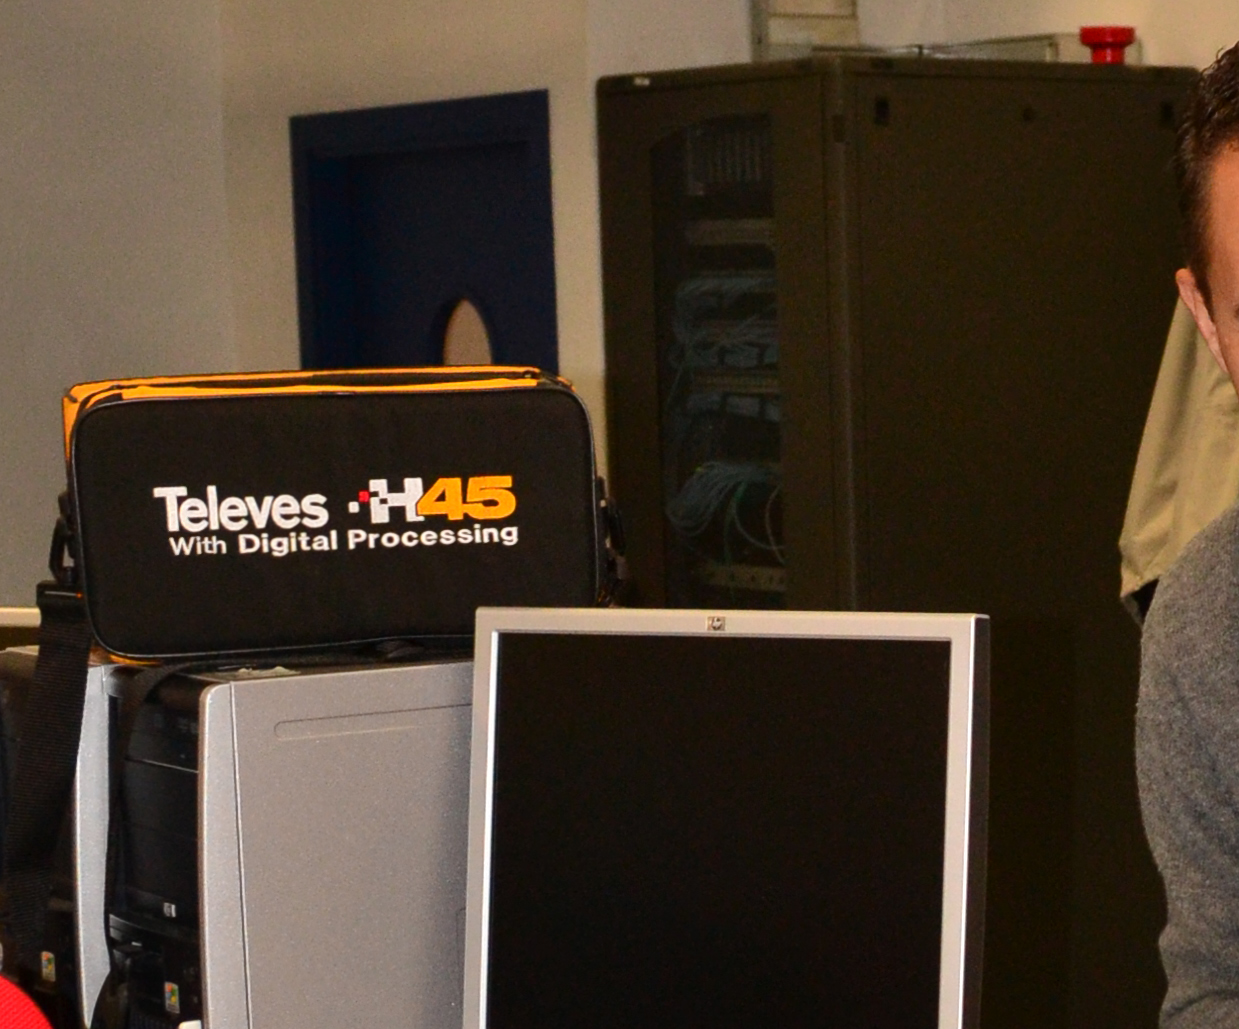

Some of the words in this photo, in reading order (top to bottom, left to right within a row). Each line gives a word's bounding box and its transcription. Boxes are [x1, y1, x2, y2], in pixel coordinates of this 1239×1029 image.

[153, 485, 330, 533] Televes
[366, 475, 517, 525] H45
[168, 535, 228, 556] With
[238, 529, 339, 558] Digital
[347, 523, 520, 550] Processing
